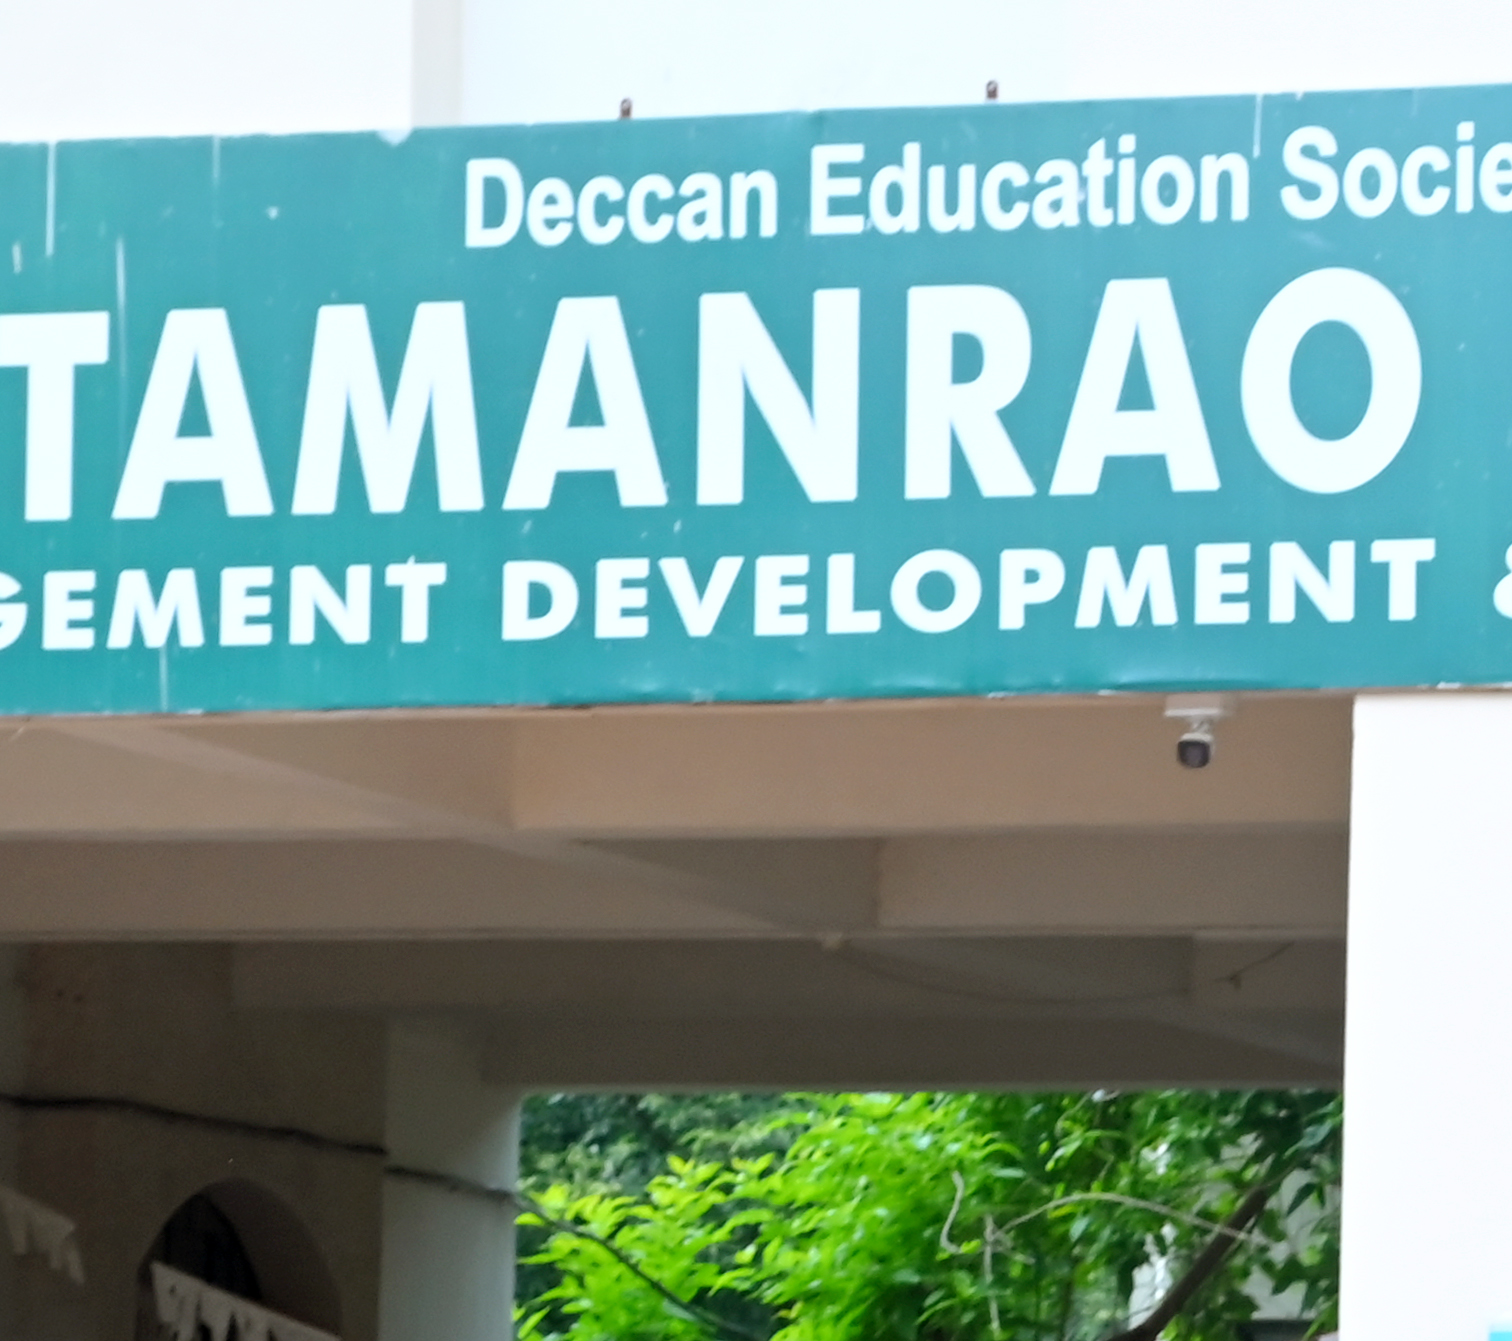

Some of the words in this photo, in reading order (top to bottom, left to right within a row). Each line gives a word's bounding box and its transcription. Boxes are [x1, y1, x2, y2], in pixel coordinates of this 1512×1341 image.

[466, 158, 777, 247] Deccan
[810, 134, 1249, 235] Education
[502, 539, 1435, 640] DEVELOPMENT
